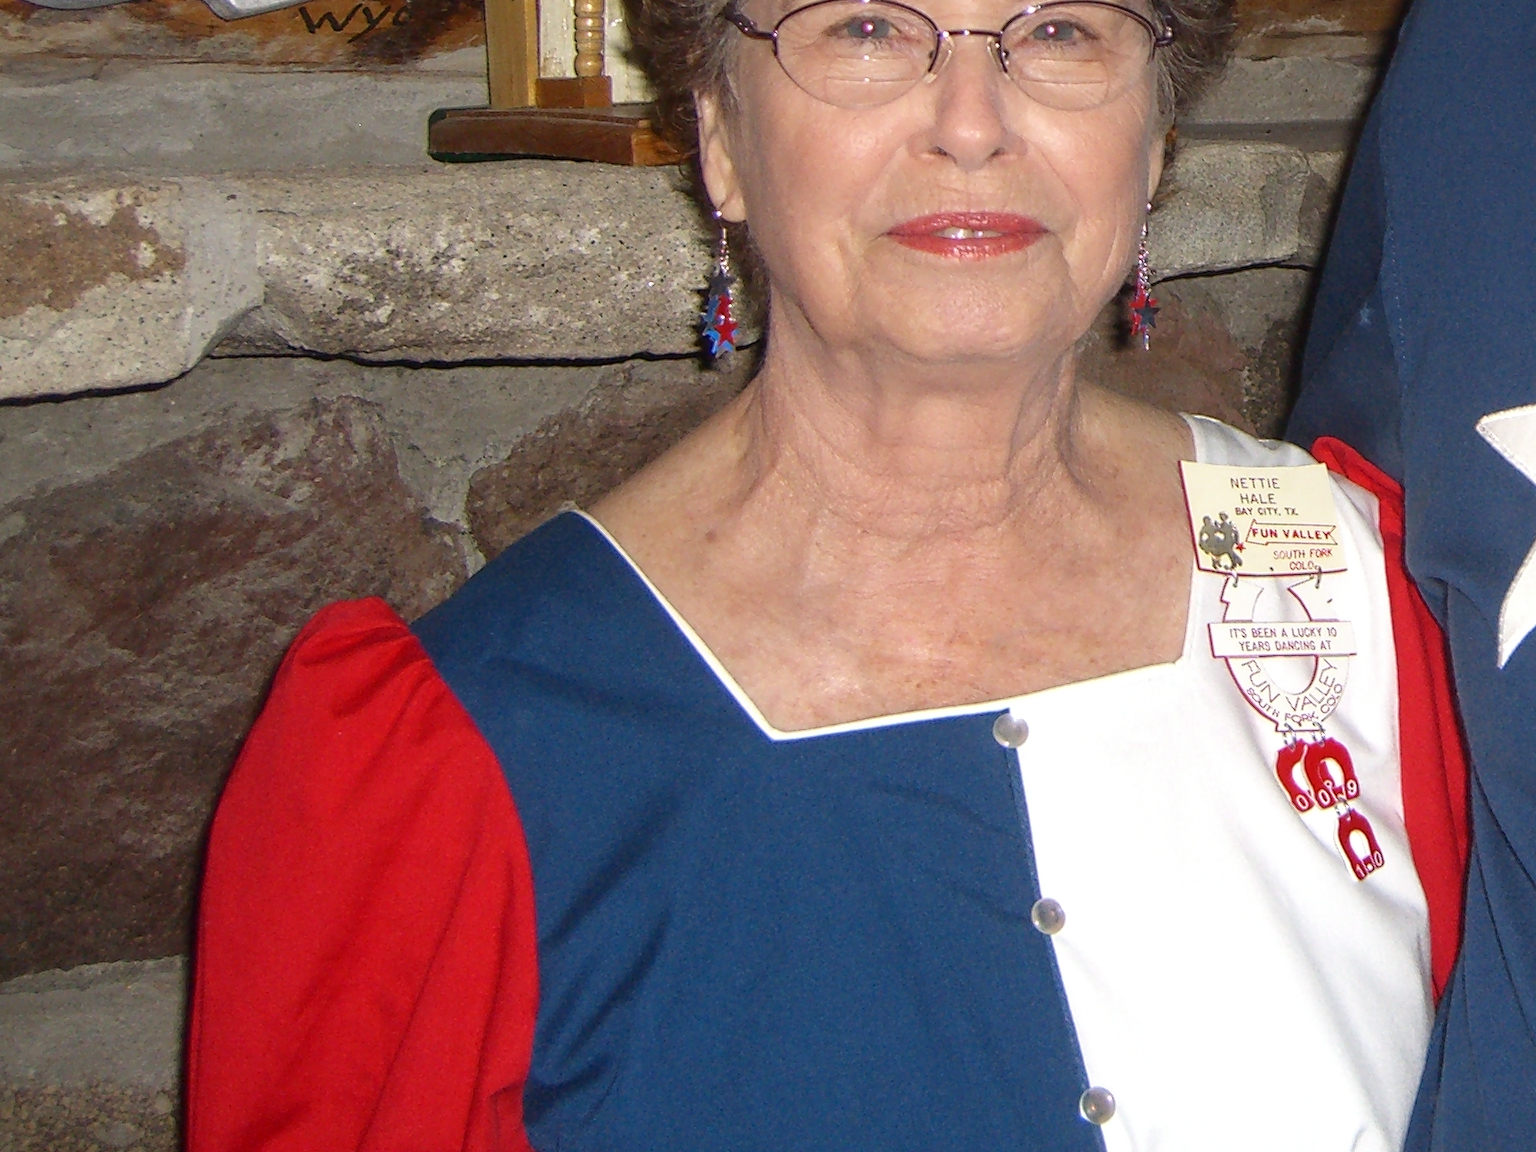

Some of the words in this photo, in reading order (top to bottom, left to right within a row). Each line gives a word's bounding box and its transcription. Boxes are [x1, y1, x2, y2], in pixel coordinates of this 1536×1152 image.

[1230, 477, 1280, 490] NETTIE
[1240, 493, 1277, 505] HALE
[1235, 507, 1252, 516] BAY
[1251, 528, 1278, 539] FUN
[1284, 529, 1331, 540] VALLEY
[1273, 550, 1306, 559] SOUTH
[1309, 548, 1333, 558] FORK
[1229, 627, 1248, 638] IT'S
[1251, 627, 1277, 638] BEEN
[1281, 628, 1288, 638] A
[1292, 627, 1322, 638] LUCKY
[1327, 627, 1338, 638] 10
[1239, 641, 1271, 652] YEARS
[1274, 640, 1316, 652] DANCING
[1320, 641, 1332, 651] AT
[1241, 659, 1280, 703] FUN
[1286, 658, 1338, 711] VALLEY
